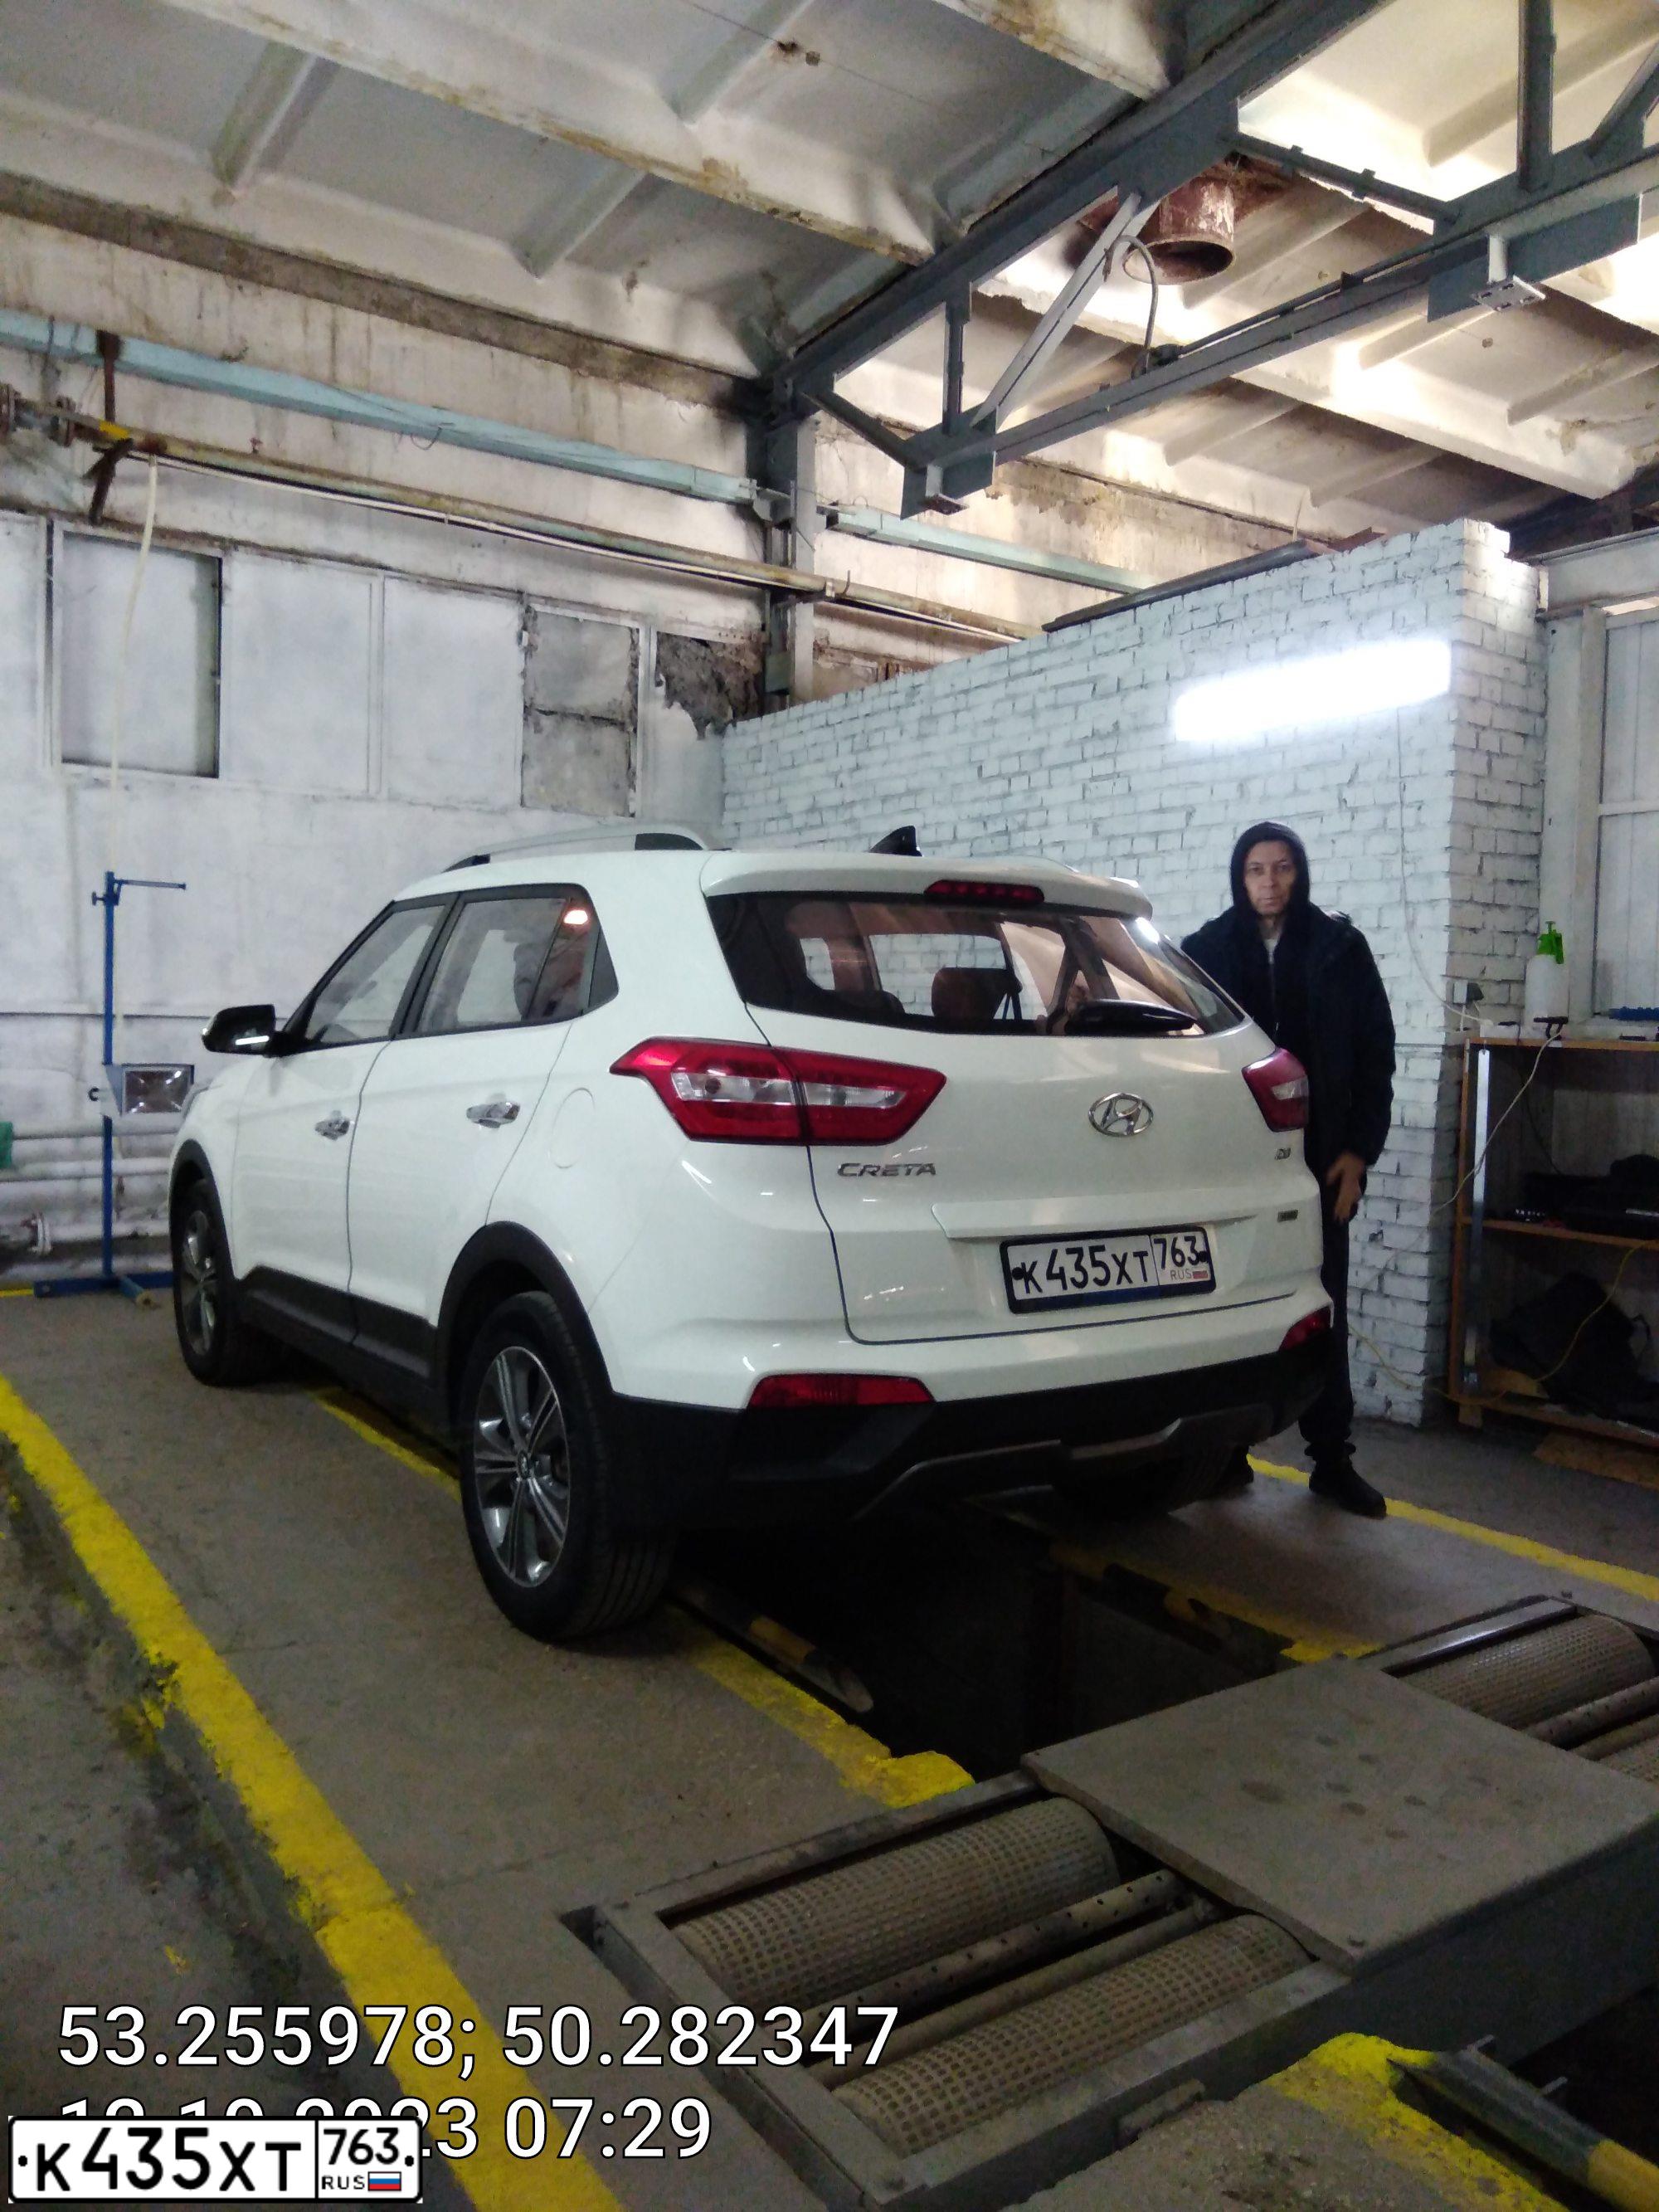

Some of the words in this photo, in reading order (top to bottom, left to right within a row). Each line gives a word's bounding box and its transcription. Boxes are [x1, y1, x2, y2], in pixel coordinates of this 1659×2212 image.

[837, 1162, 937, 1177] CRETA
[1153, 1235, 1199, 1270] 763
[1170, 1269, 1192, 1279] RUS
